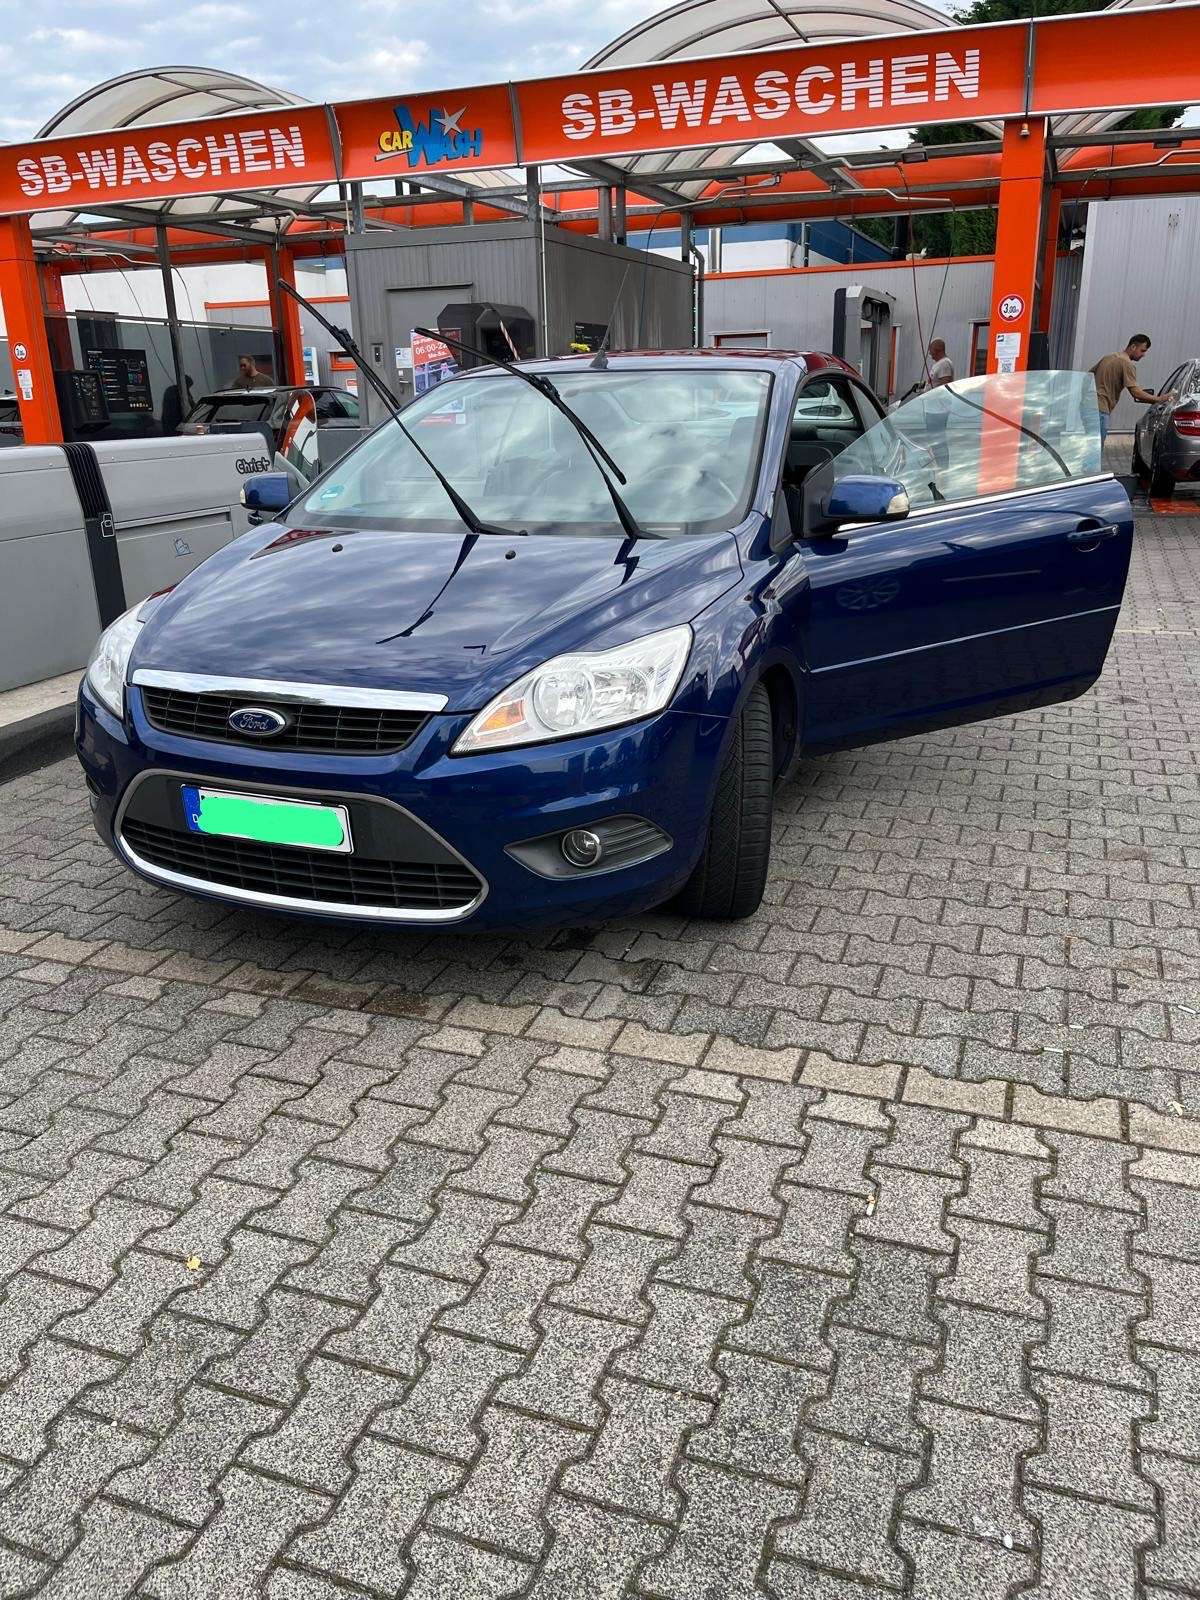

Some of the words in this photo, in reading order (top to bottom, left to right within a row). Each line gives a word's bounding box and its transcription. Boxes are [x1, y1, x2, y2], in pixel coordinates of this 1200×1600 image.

[561, 49, 980, 141] SB-WASCHEN
[378, 130, 414, 152] CAR
[393, 105, 484, 168] WASH
[16, 126, 306, 197] SB-WASCHEN
[235, 456, 270, 474] Christ
[240, 713, 269, 730] Ford
